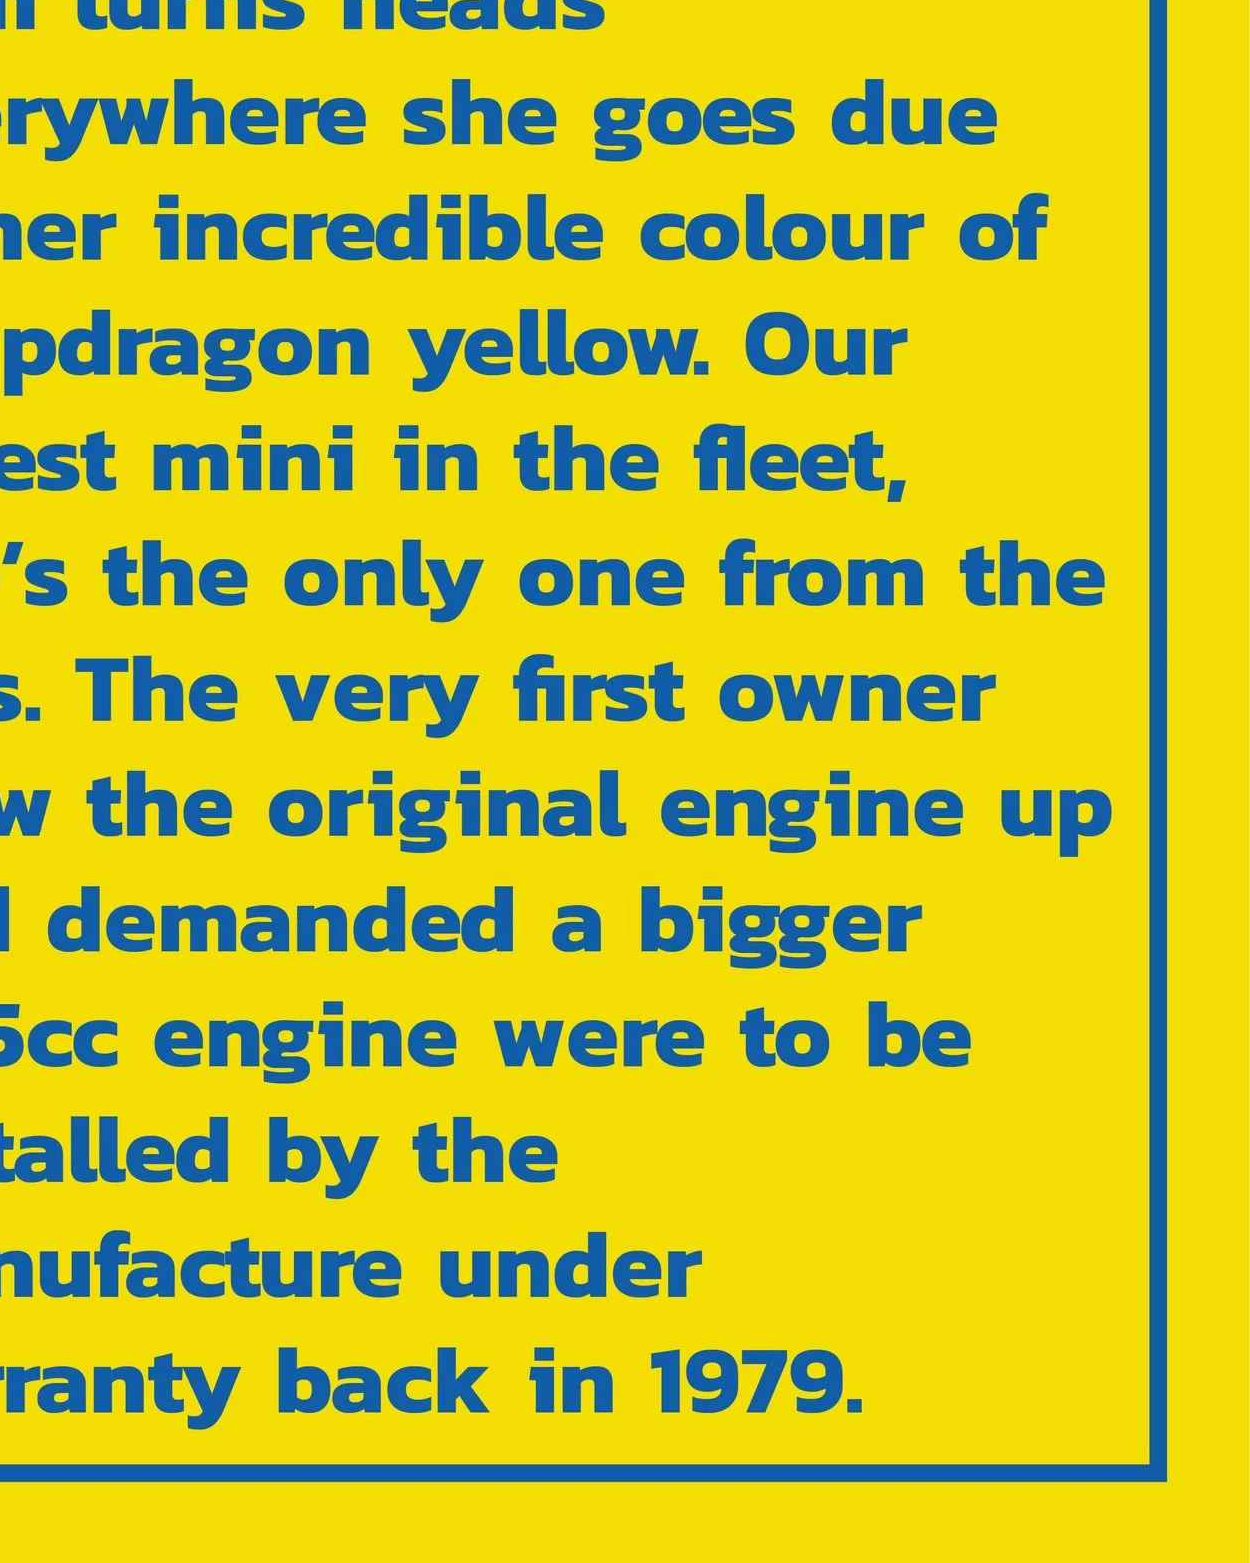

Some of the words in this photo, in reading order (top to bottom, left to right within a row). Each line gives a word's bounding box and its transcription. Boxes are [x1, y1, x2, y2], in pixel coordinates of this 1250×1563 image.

[404, 79, 556, 145] she
[593, 97, 795, 161] goes
[831, 79, 997, 145] due
[153, 194, 603, 261] incredible
[641, 194, 925, 261] colour
[959, 193, 1049, 261] of
[409, 309, 709, 393] yellow.
[746, 311, 909, 375] Our
[154, 425, 352, 491] mini
[393, 425, 477, 491] in
[514, 425, 659, 491] the
[694, 423, 905, 502] fleet,
[103, 539, 247, 607] the
[283, 539, 483, 623] only
[519, 559, 685, 607] one
[719, 538, 923, 607] from
[960, 539, 1105, 607] the
[75, 655, 237, 721] The
[276, 674, 478, 738] very
[513, 653, 685, 721] first
[719, 674, 997, 721] owner
[85, 771, 233, 837] the
[269, 769, 627, 853] original
[661, 771, 963, 853] engine
[1002, 789, 1111, 857] up
[48, 885, 513, 953] demanded
[551, 905, 601, 953] a
[642, 885, 923, 969] bigger
[154, 1001, 456, 1085] engine
[493, 1019, 704, 1067] were
[740, 1007, 829, 1067] to
[868, 1001, 971, 1067] be
[269, 1117, 378, 1199] by
[413, 1117, 557, 1183] the
[439, 1232, 702, 1298] under
[279, 1347, 488, 1413] back
[529, 1347, 613, 1413] in
[651, 1349, 862, 1413] 1979.
